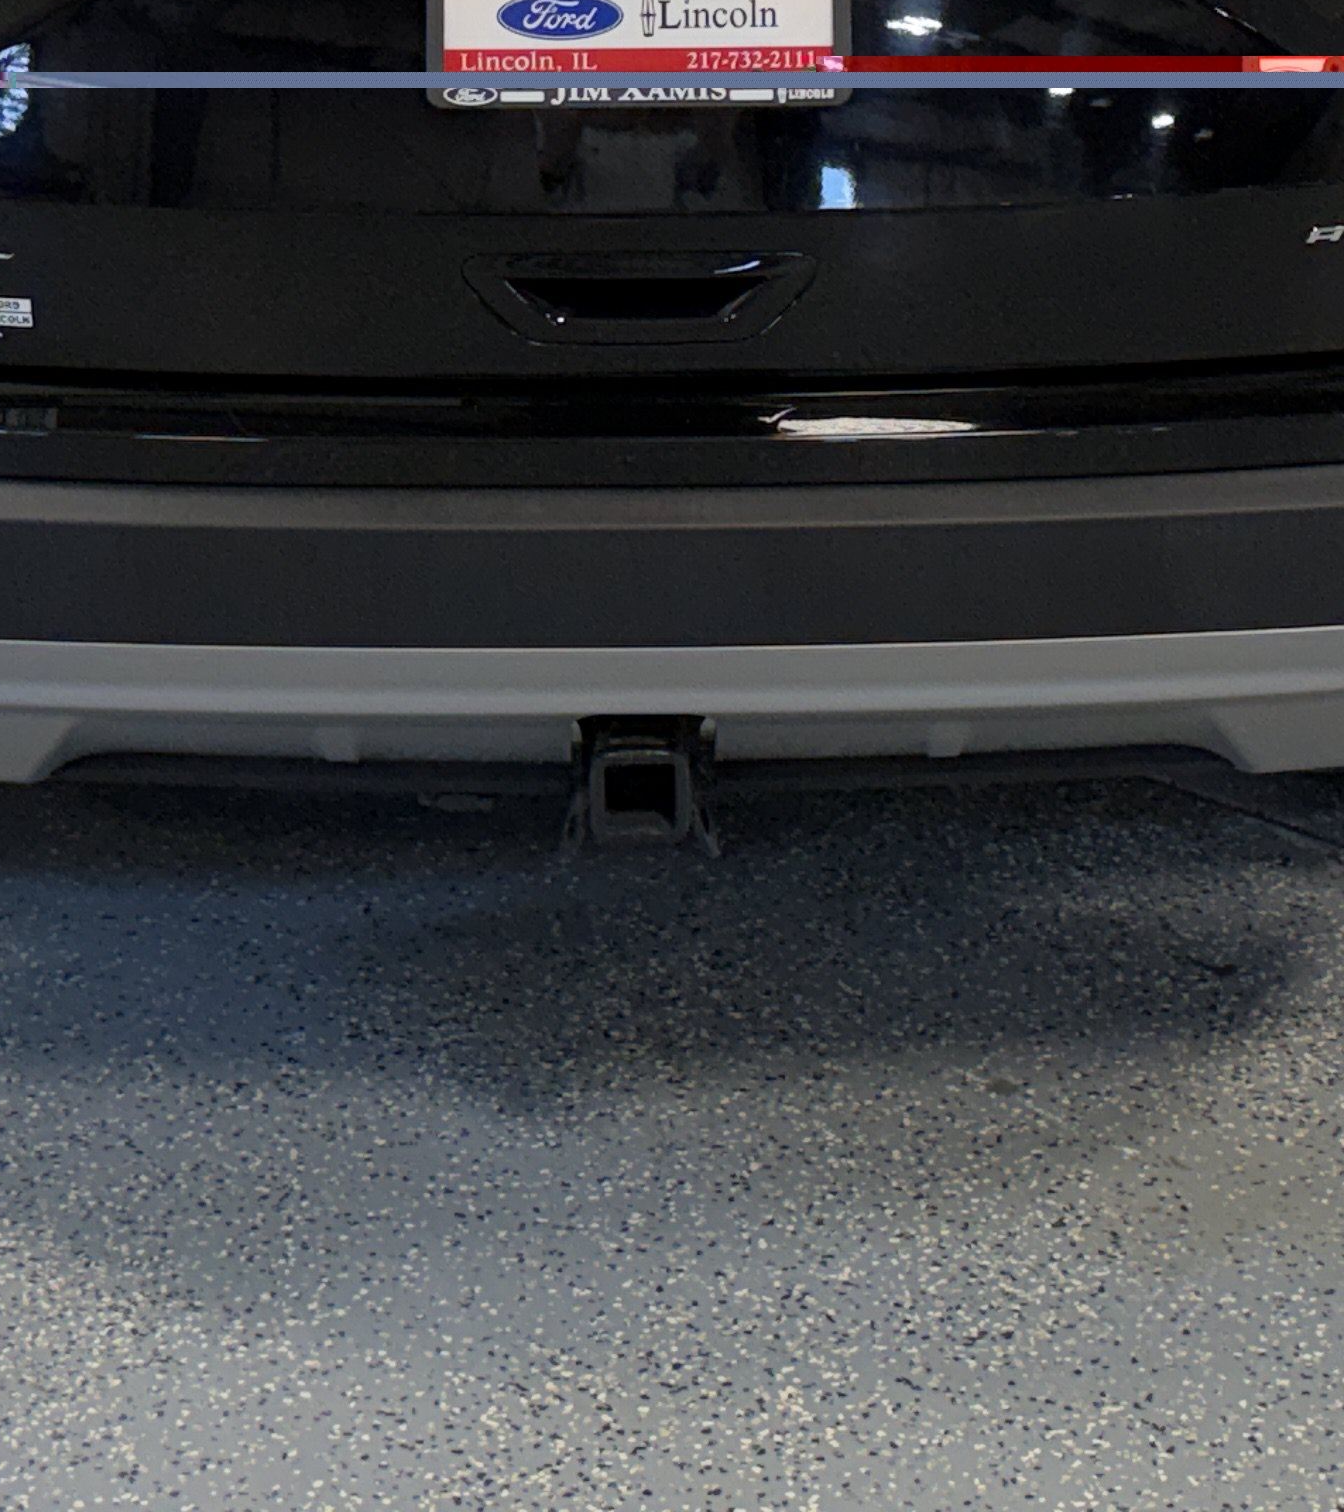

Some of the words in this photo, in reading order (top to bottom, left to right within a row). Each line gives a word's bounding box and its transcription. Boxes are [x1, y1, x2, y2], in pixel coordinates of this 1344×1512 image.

[522, 0, 597, 31] Ford
[658, 0, 778, 30] Lincoln
[460, 51, 563, 72] Lincoln,
[572, 52, 598, 71] IL
[687, 50, 816, 70] 217-732-2111
